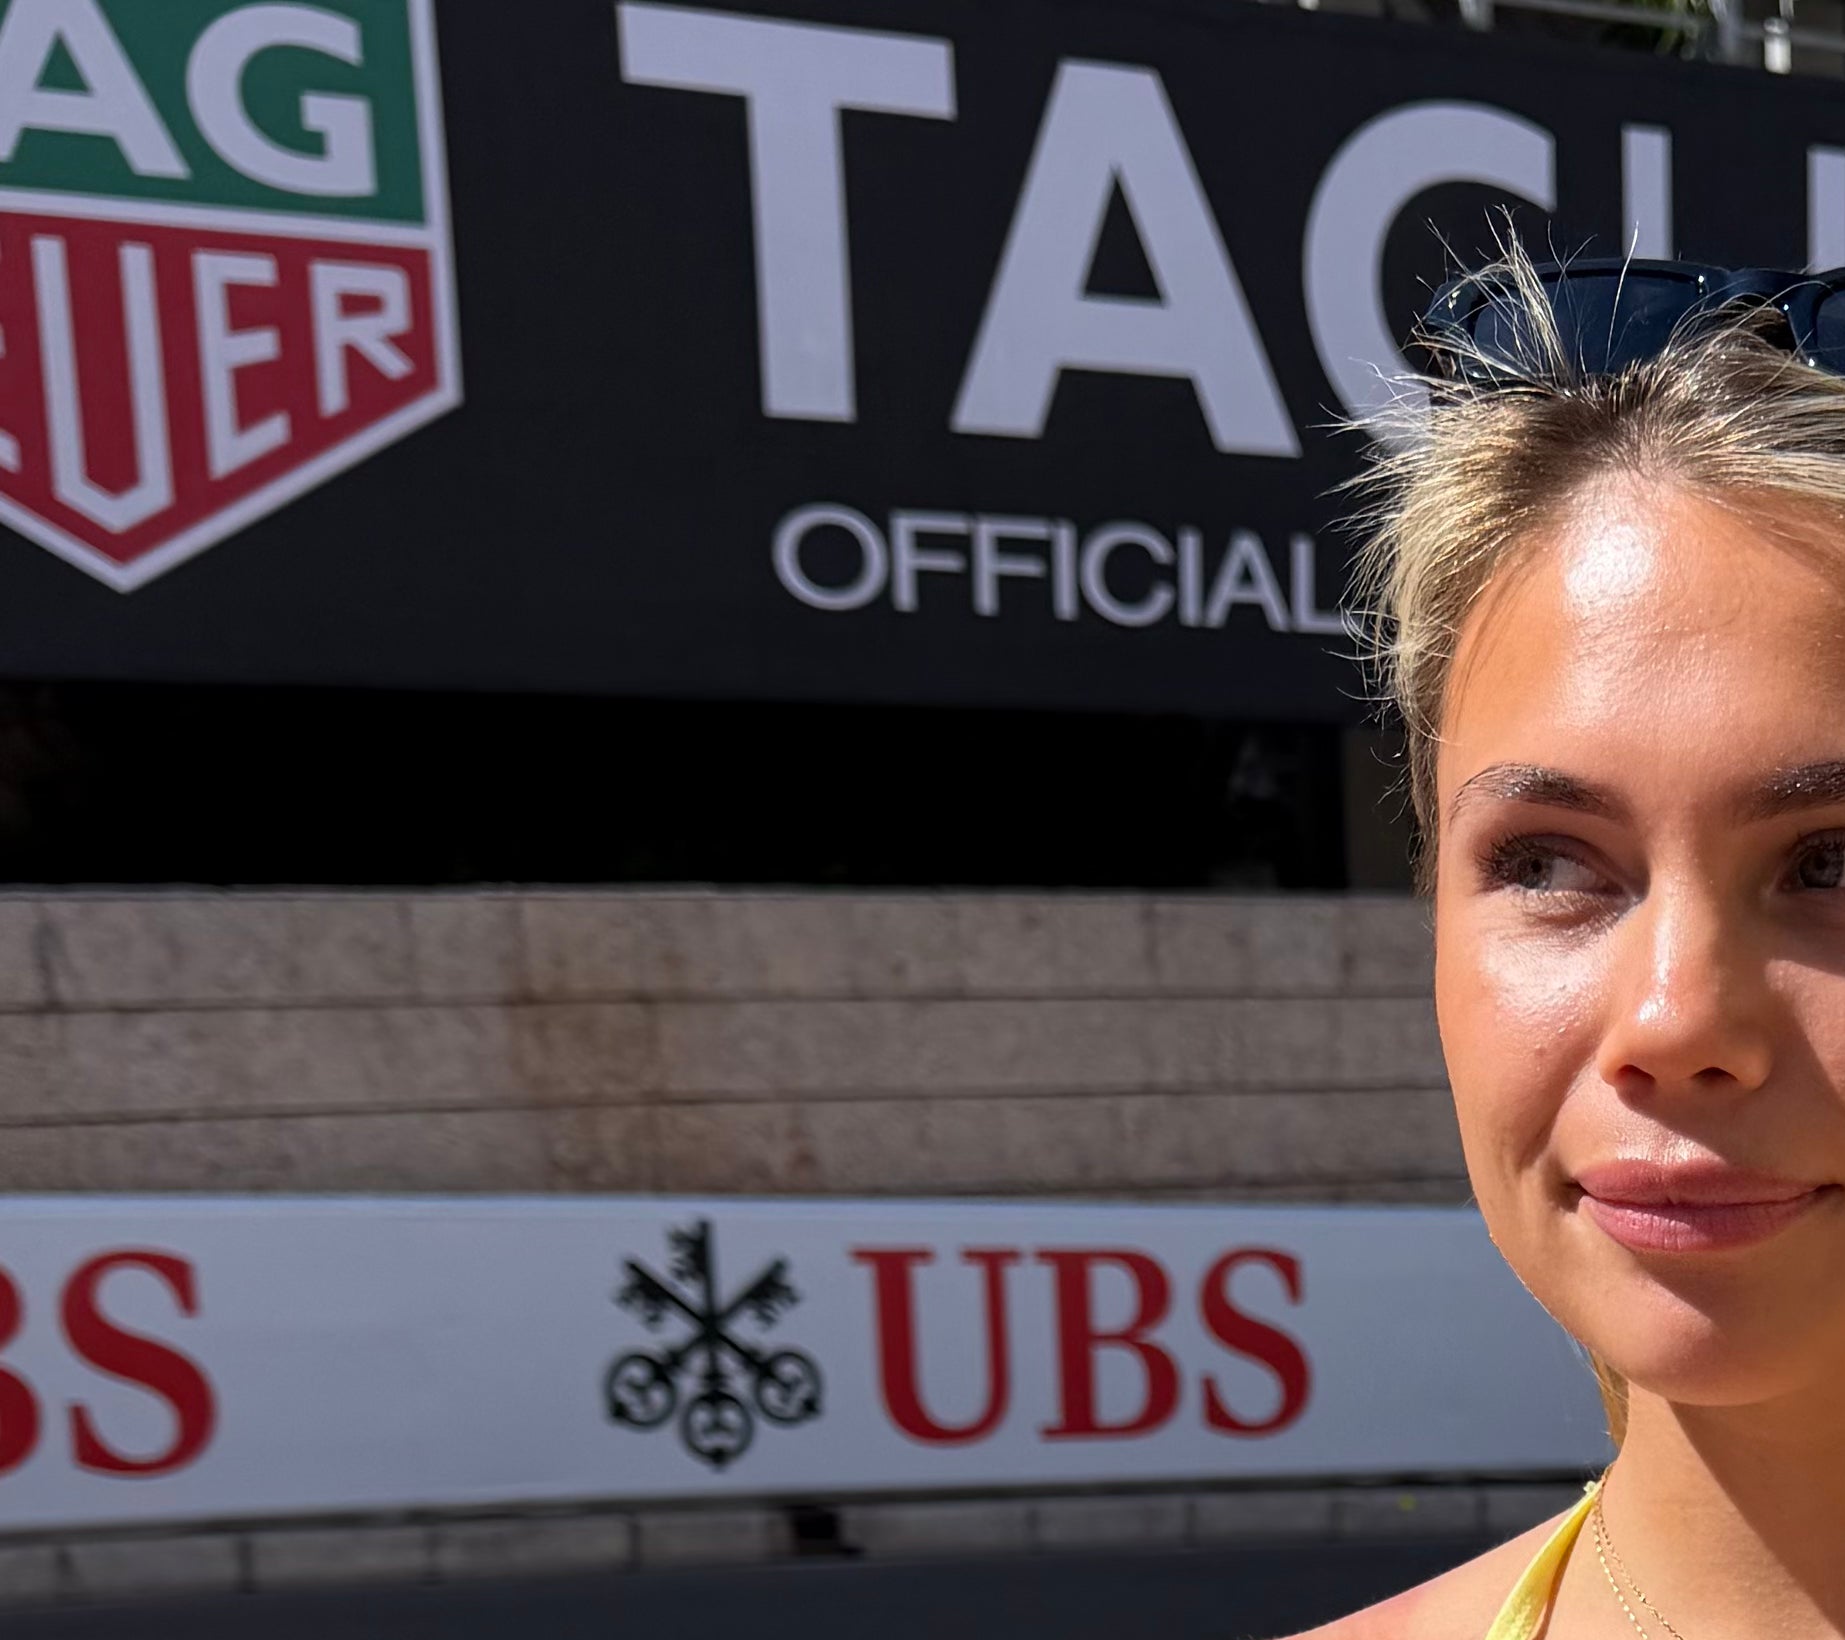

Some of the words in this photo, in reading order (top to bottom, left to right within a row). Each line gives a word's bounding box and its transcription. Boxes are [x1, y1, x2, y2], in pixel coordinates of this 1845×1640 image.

[0, 234, 415, 534] UER
[772, 500, 1350, 636] OFFICIAL
[851, 1248, 1315, 1447] UBS
